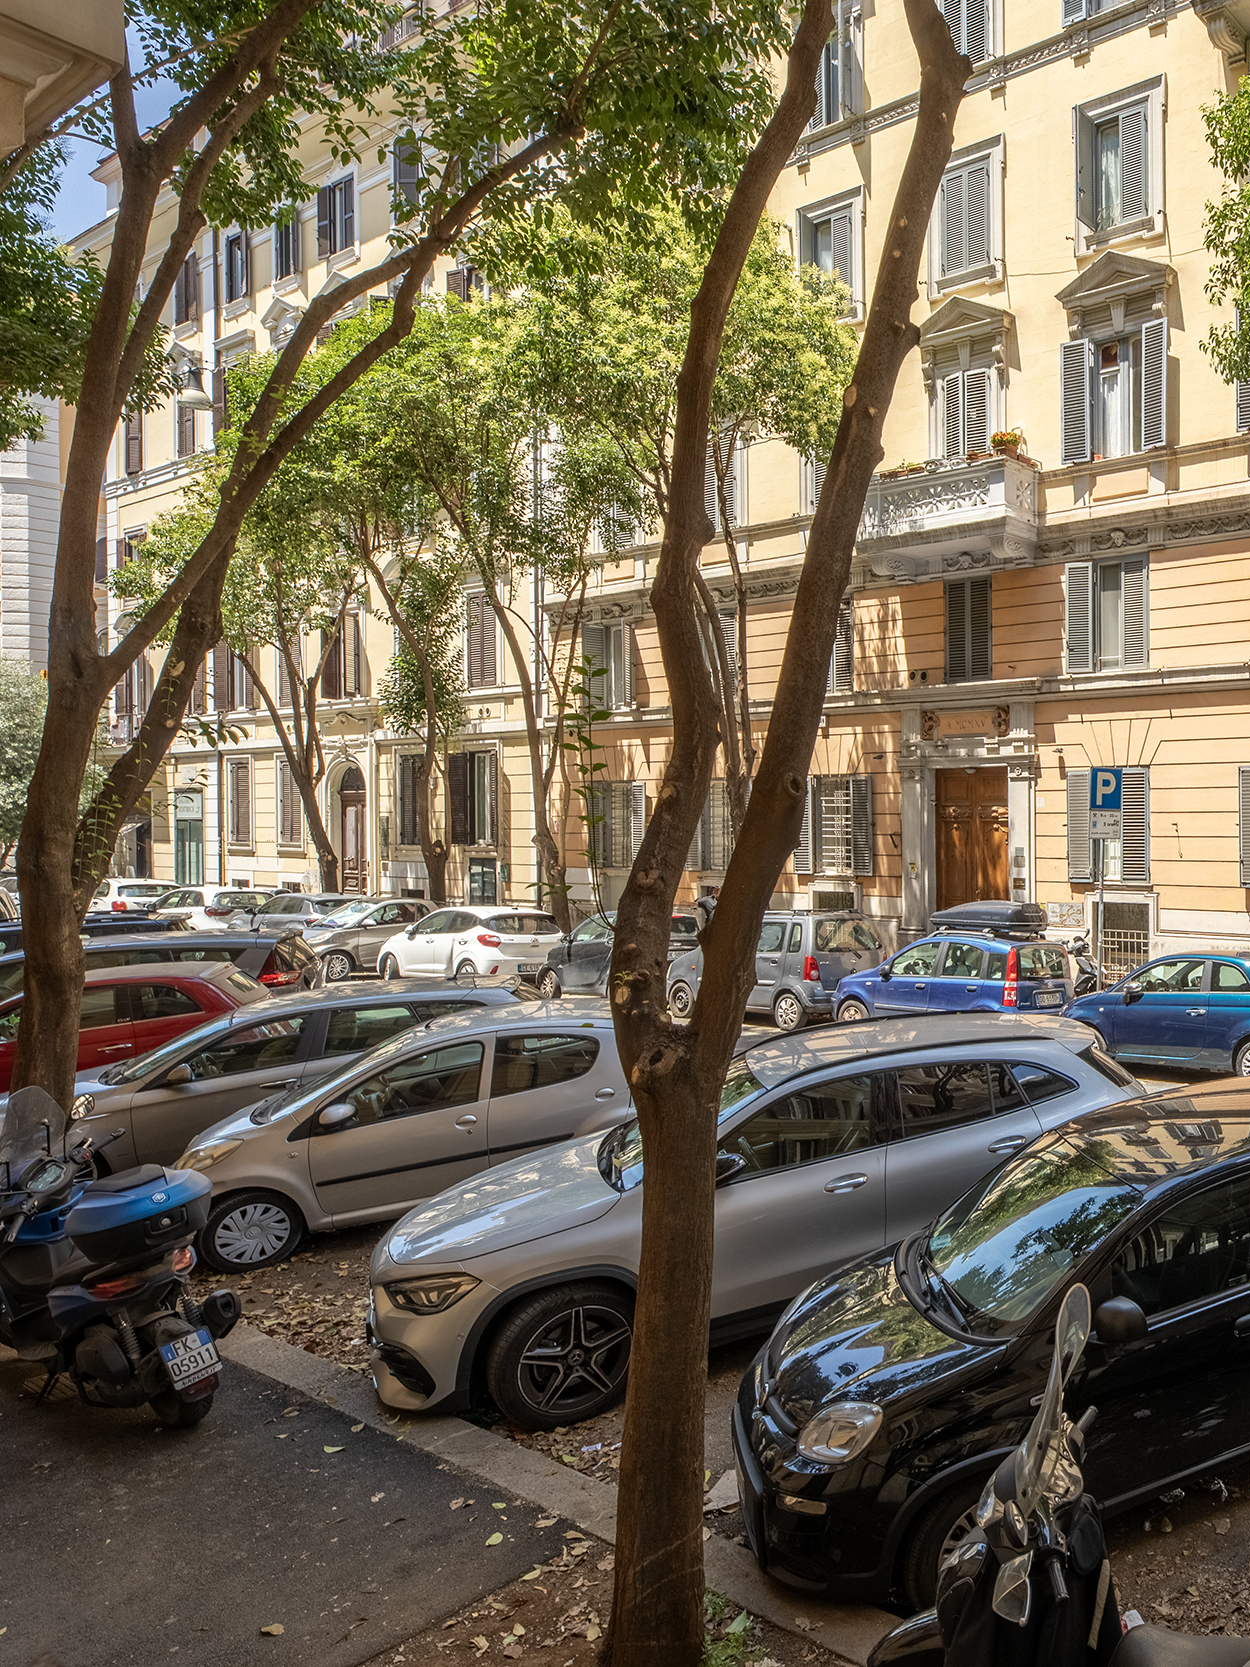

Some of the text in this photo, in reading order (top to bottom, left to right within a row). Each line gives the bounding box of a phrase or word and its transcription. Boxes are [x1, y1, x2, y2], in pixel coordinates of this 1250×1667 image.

[1096, 771, 1117, 806] P
[172, 1336, 193, 1357] FK
[170, 1347, 214, 1377] 05911
